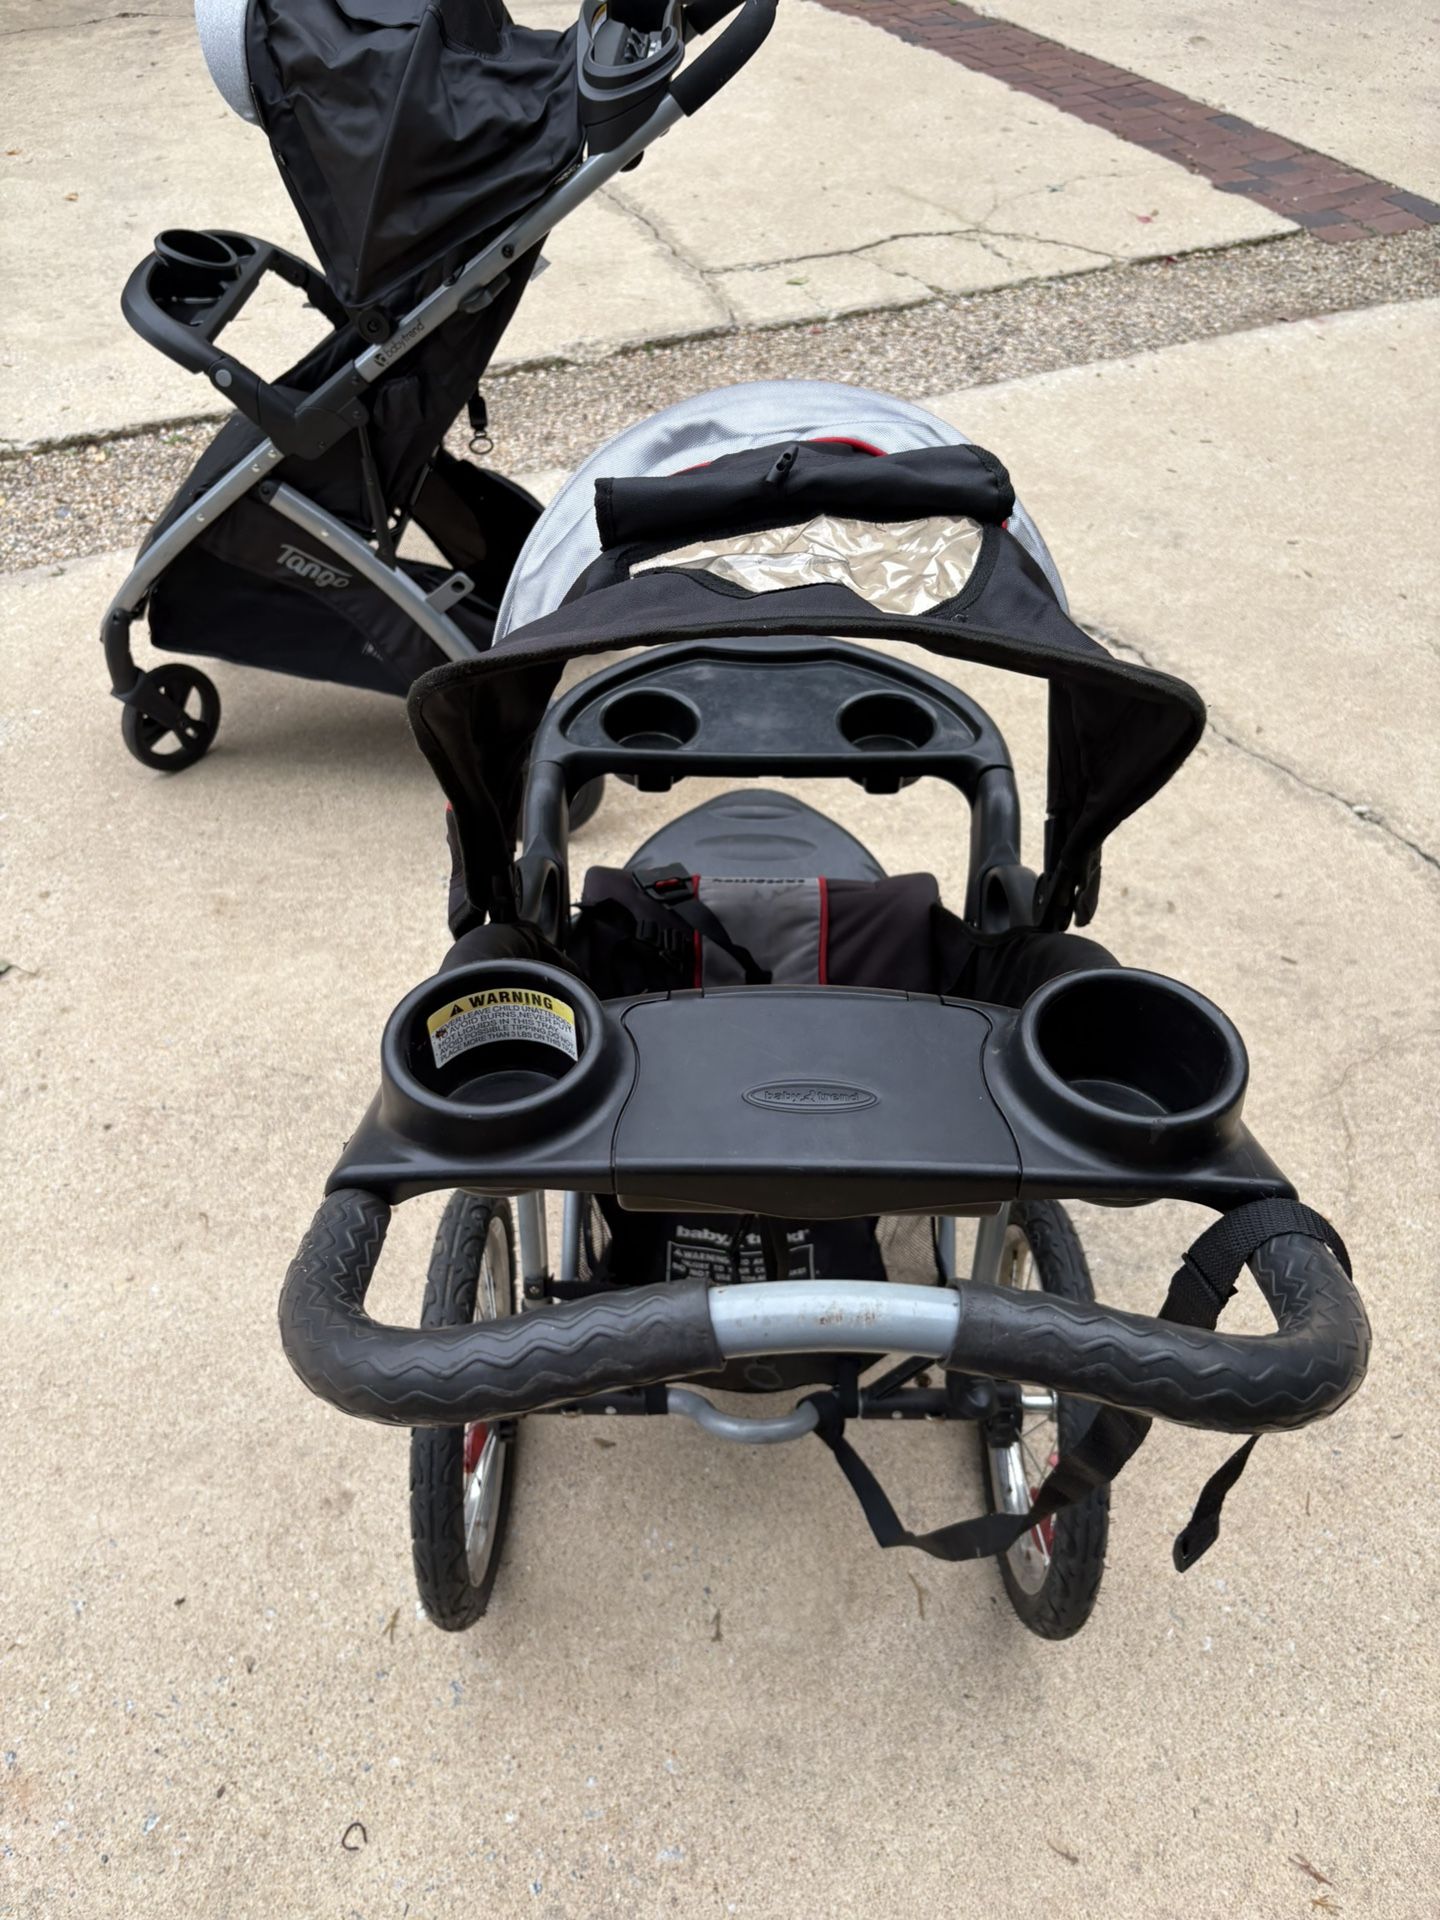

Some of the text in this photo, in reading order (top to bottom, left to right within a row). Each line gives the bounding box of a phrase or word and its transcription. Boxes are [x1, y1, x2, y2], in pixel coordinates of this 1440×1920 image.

[276, 544, 352, 588] Tango
[468, 991, 554, 1011] WARNING
[463, 1006, 491, 1020] LEAVE
[492, 1004, 520, 1013] CHILD
[450, 1017, 479, 1034] AVOID
[457, 1020, 497, 1038] LIQUIDS
[499, 1018, 510, 1026] IN
[511, 1018, 535, 1027] THIS
[440, 1037, 464, 1056] AVOID
[464, 1024, 509, 1041] POSSIBLE
[511, 1024, 547, 1035] TIPPING
[464, 1036, 486, 1049] MORE
[488, 1031, 510, 1040] THAN
[764, 1090, 860, 1102] baby trend
[676, 1225, 729, 1246] baby
